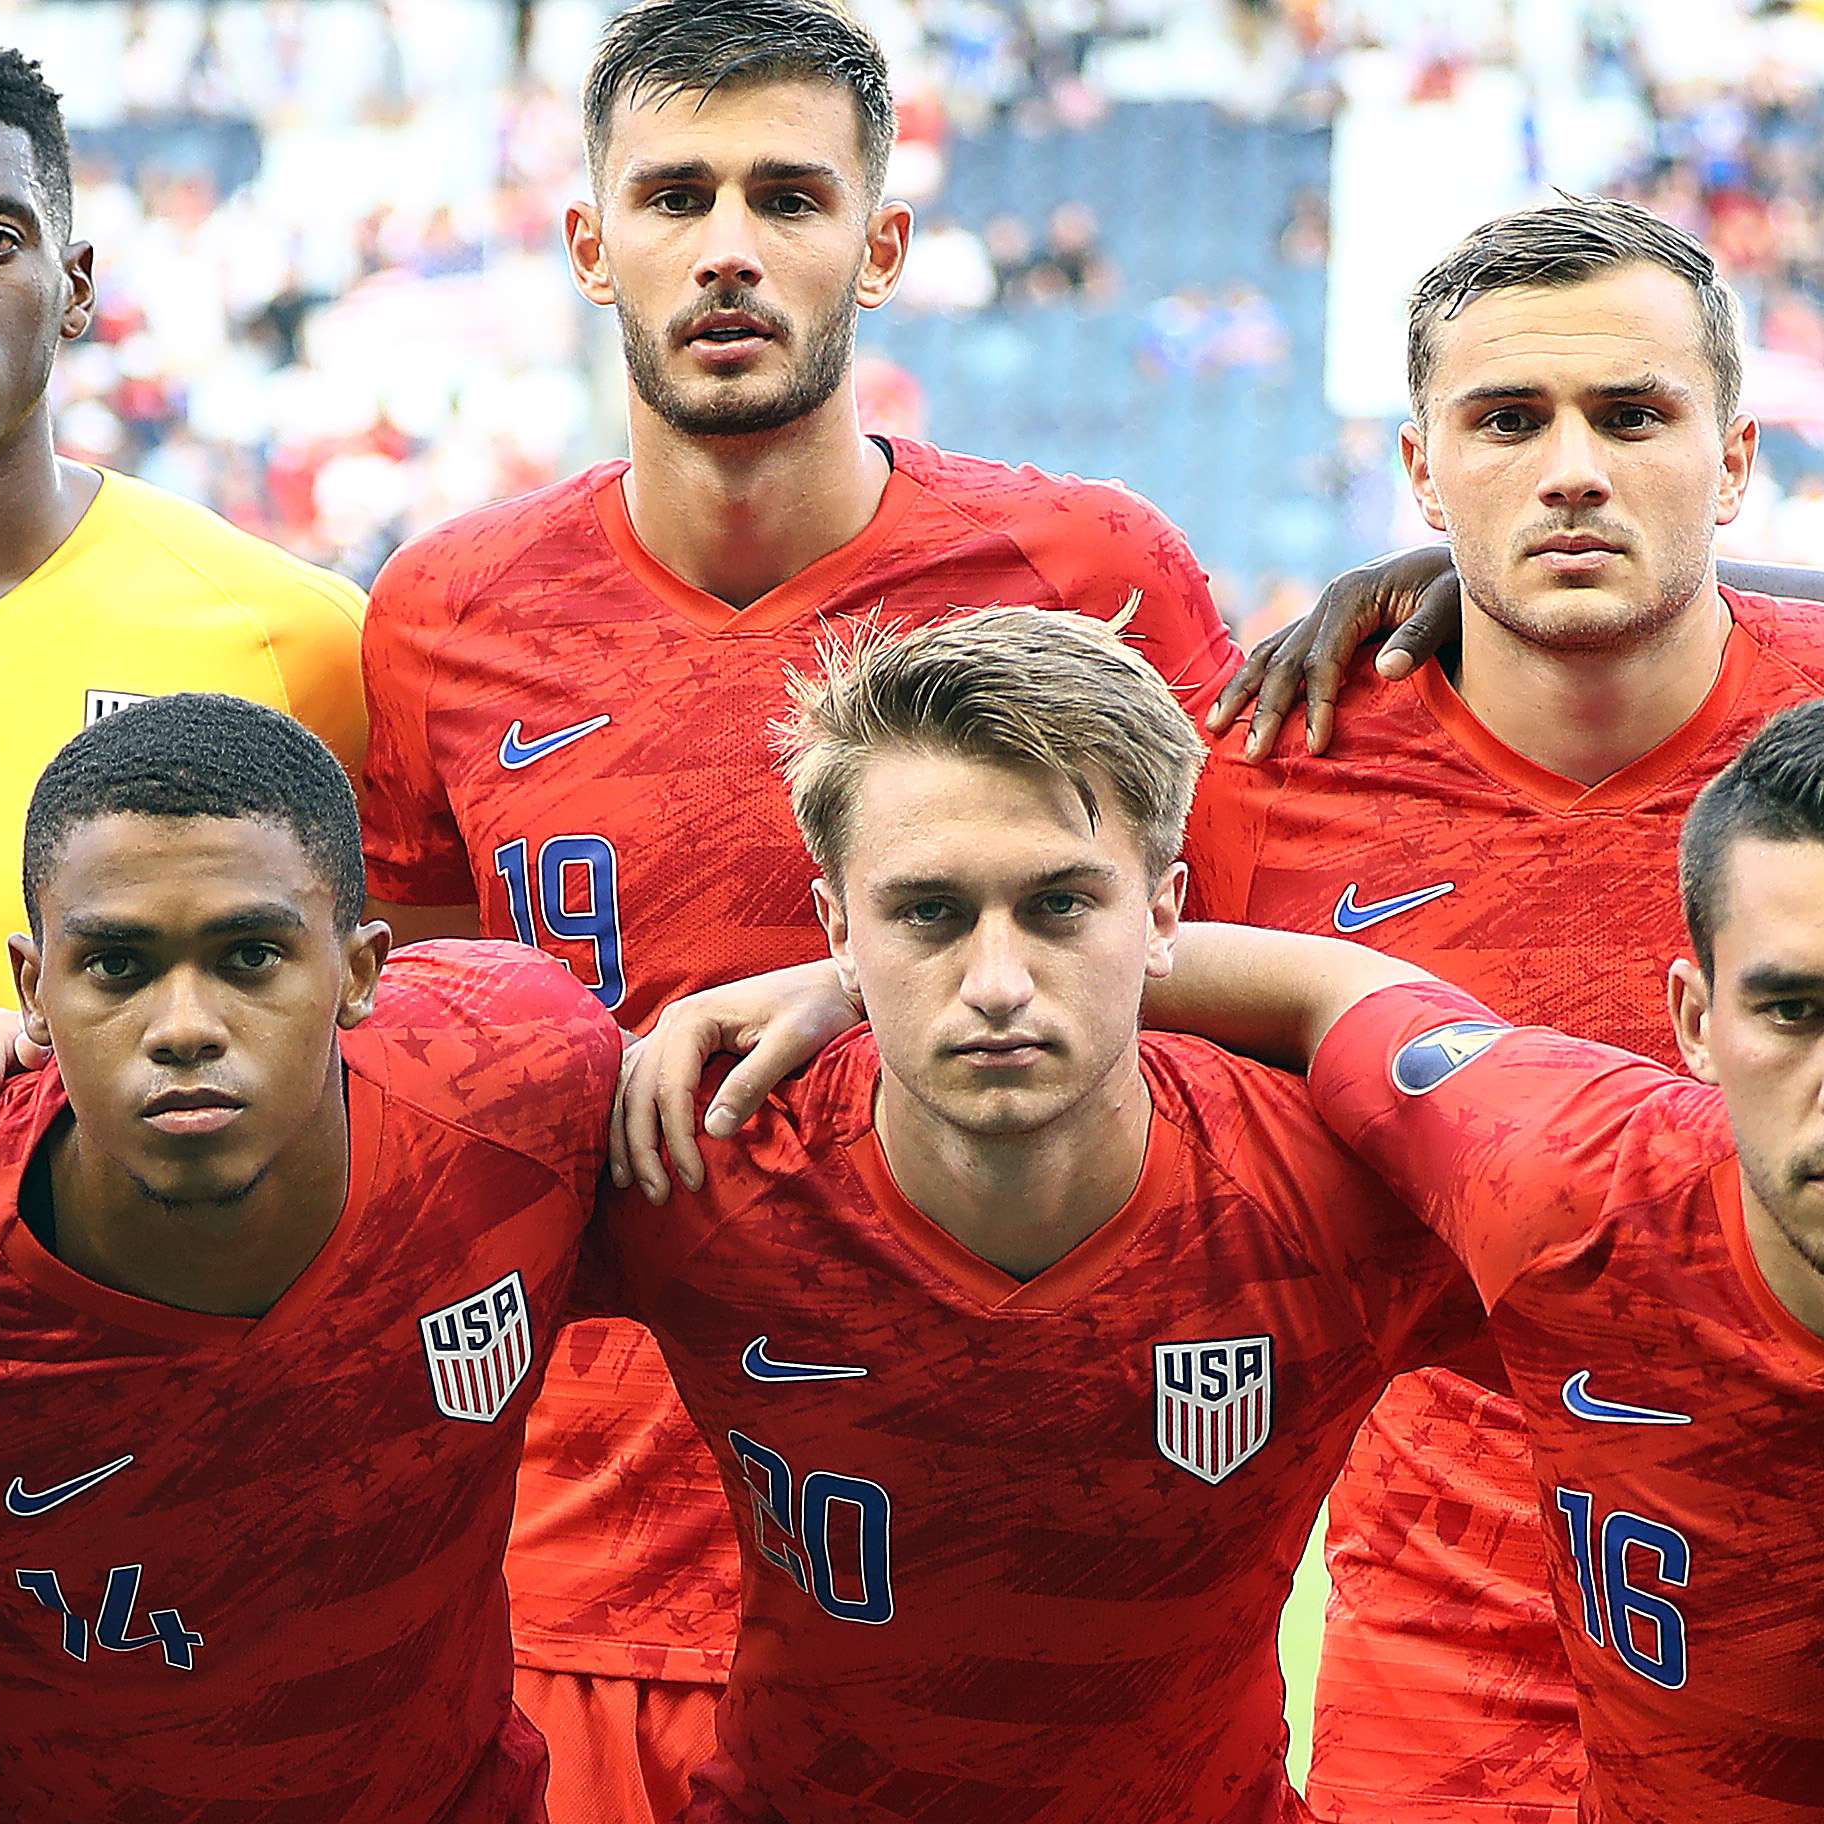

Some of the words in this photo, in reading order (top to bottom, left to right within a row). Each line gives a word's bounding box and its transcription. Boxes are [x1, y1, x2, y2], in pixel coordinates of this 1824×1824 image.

[494, 833, 627, 1010] 19
[431, 1283, 519, 1352] USA
[1163, 1344, 1263, 1402] USA
[14, 1563, 204, 1671] 14
[1555, 1485, 1690, 1690] 16
